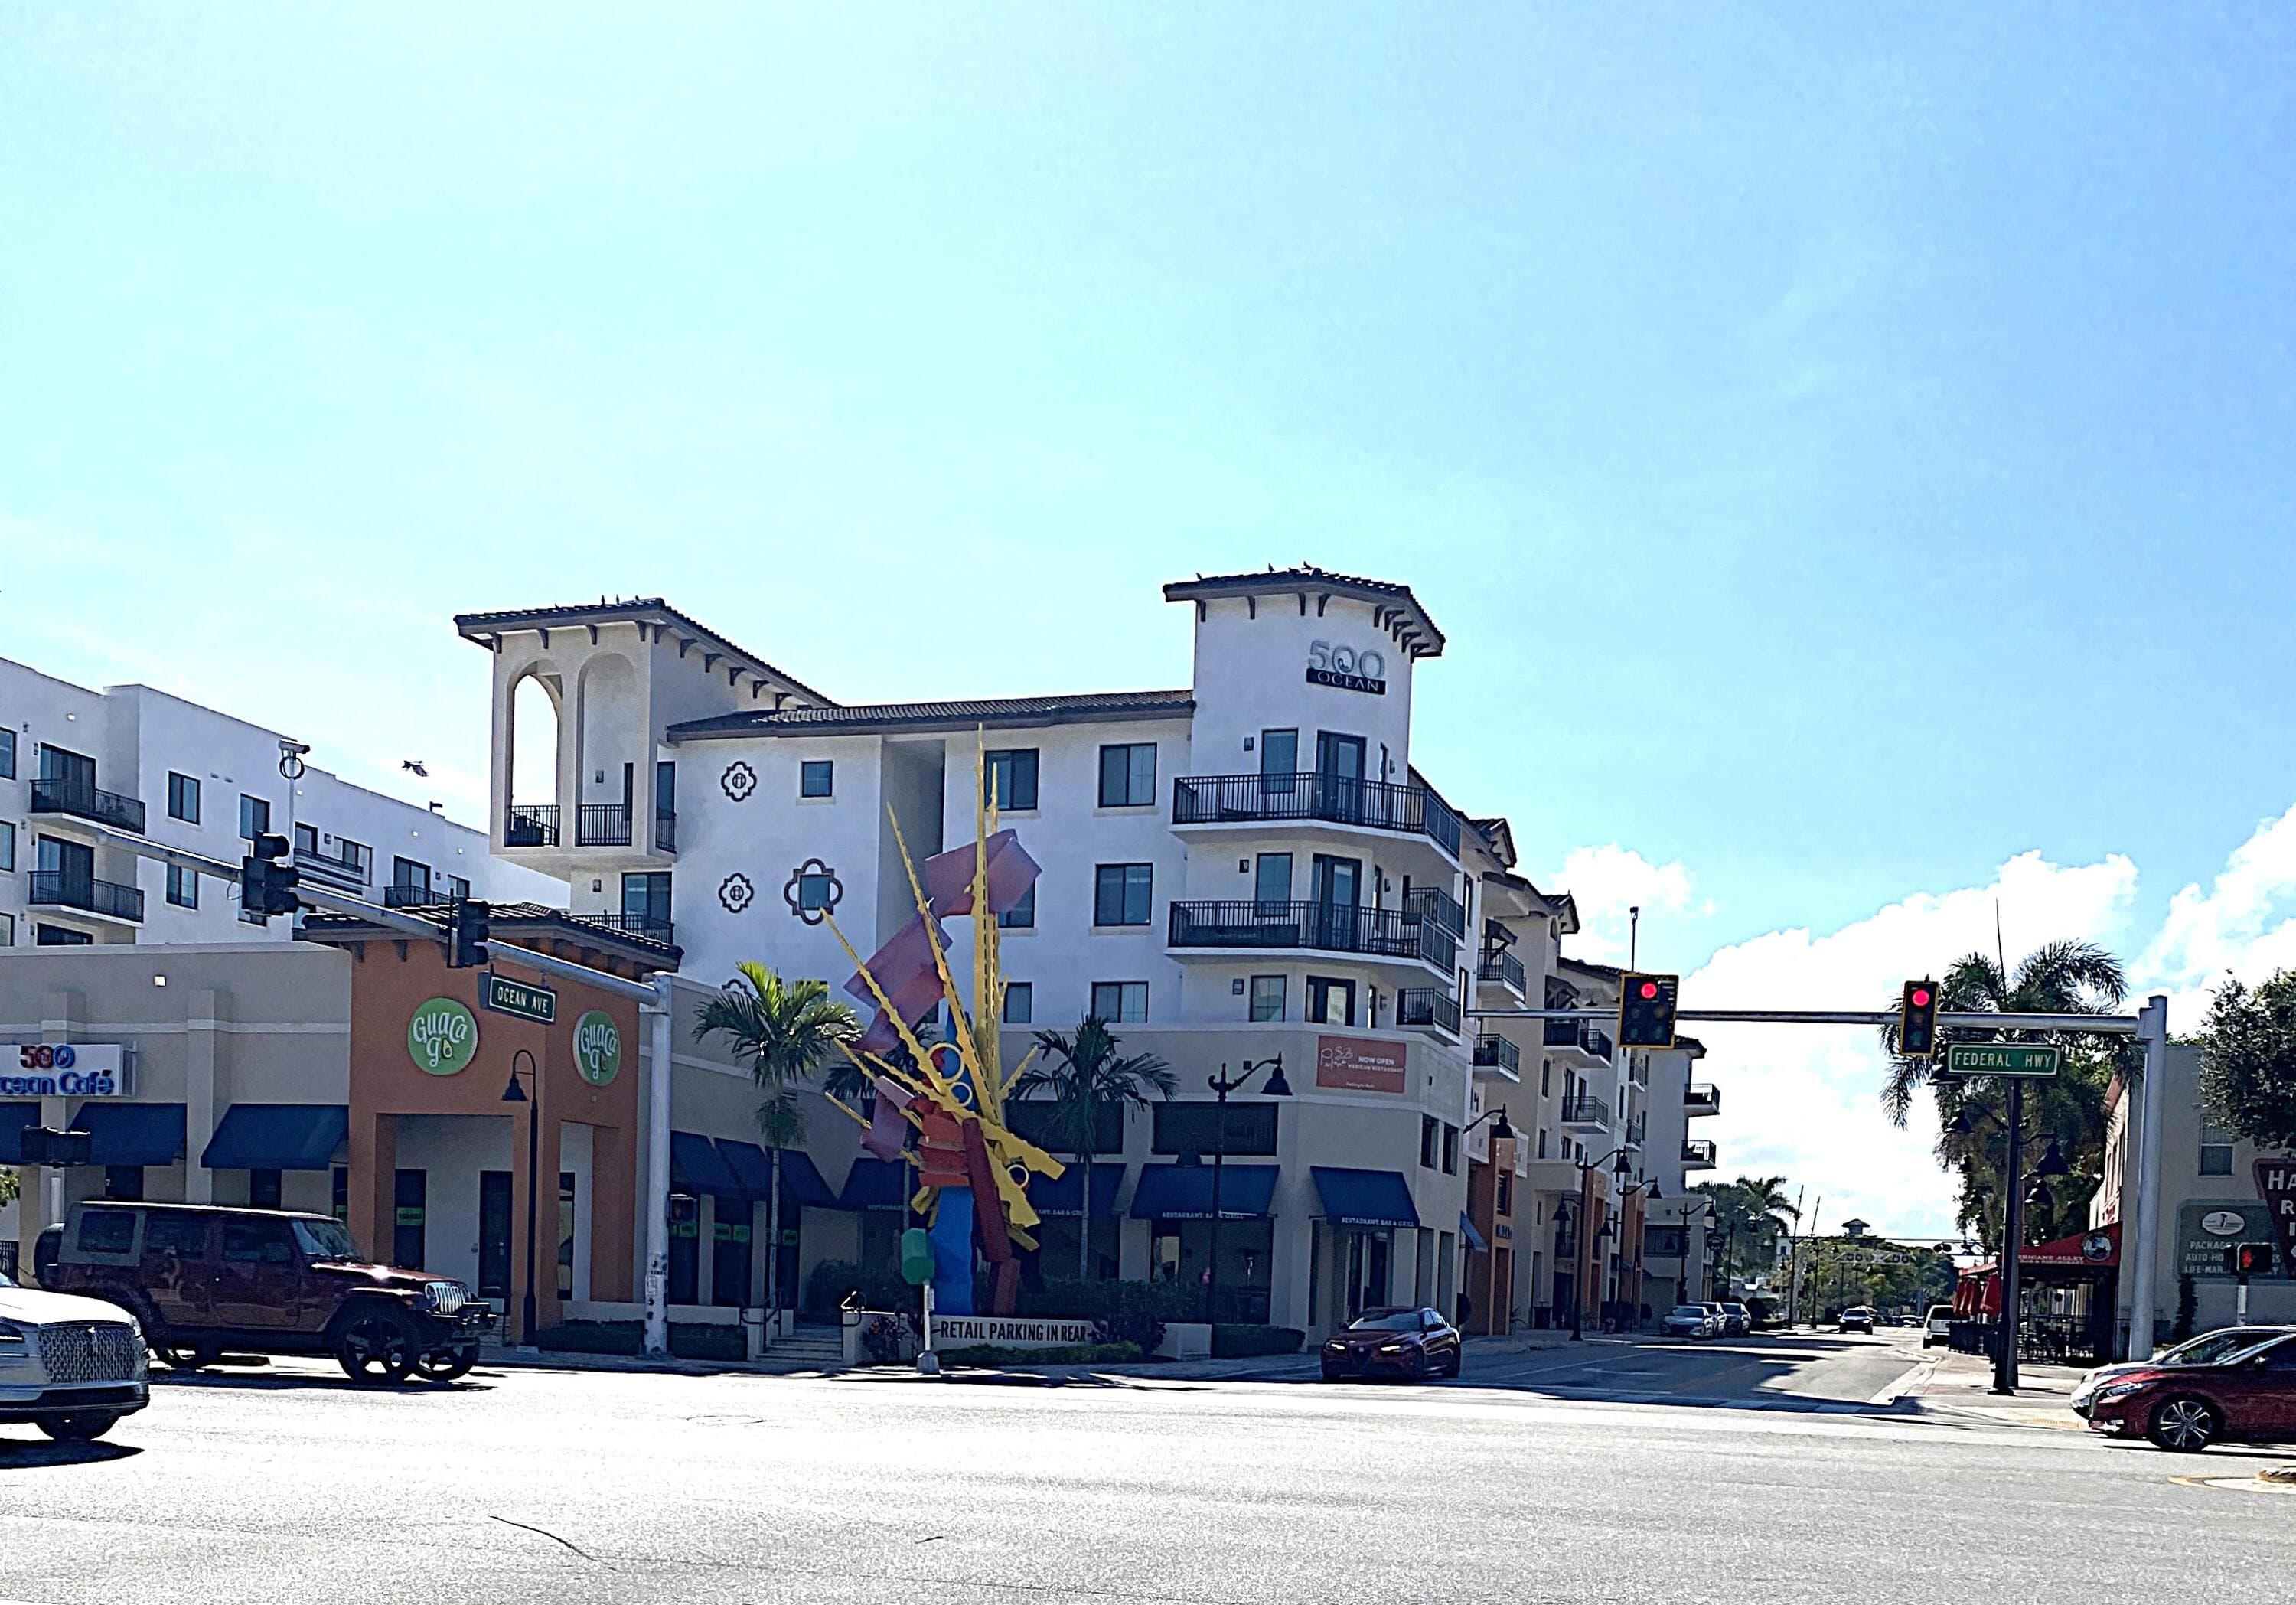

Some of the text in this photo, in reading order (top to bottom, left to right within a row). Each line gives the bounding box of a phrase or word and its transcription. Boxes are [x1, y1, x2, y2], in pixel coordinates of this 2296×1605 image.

[1309, 641, 1385, 677] 500
[1318, 672, 1378, 691] OCEAN
[497, 986, 548, 1013] OCEAN AVE
[20, 1045, 75, 1068] 500
[1955, 1052, 2052, 1068] FEDERAL HWY
[59, 1069, 114, 1094] Café
[941, 1321, 1086, 1342] RETAIL PARKING IN REAR
